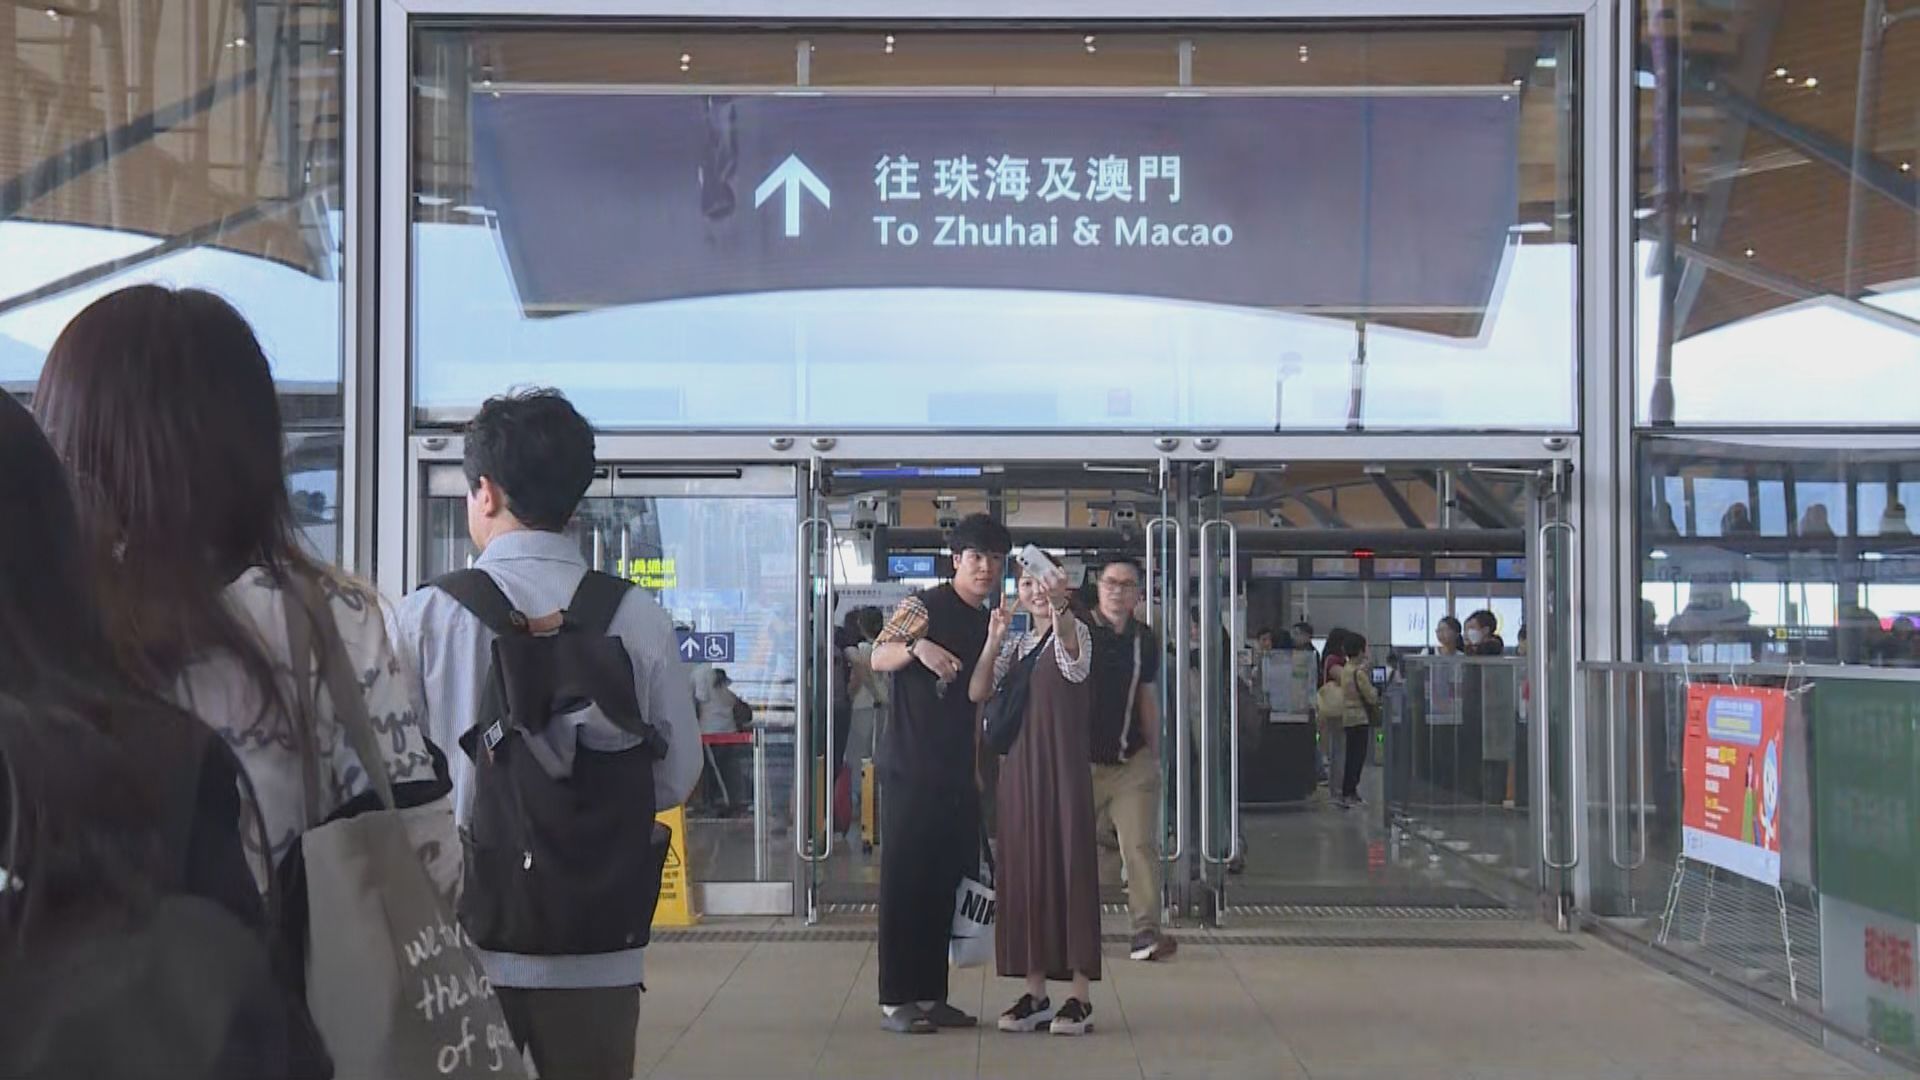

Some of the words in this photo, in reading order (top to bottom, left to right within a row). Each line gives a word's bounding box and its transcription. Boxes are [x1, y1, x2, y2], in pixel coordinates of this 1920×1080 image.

[874, 154, 1183, 204] 往珠海及澳門
[873, 215, 920, 247] To
[933, 214, 1059, 247] Zhuhai
[1073, 216, 1101, 247] &
[1115, 216, 1234, 247] Macao
[437, 1016, 477, 1074] of
